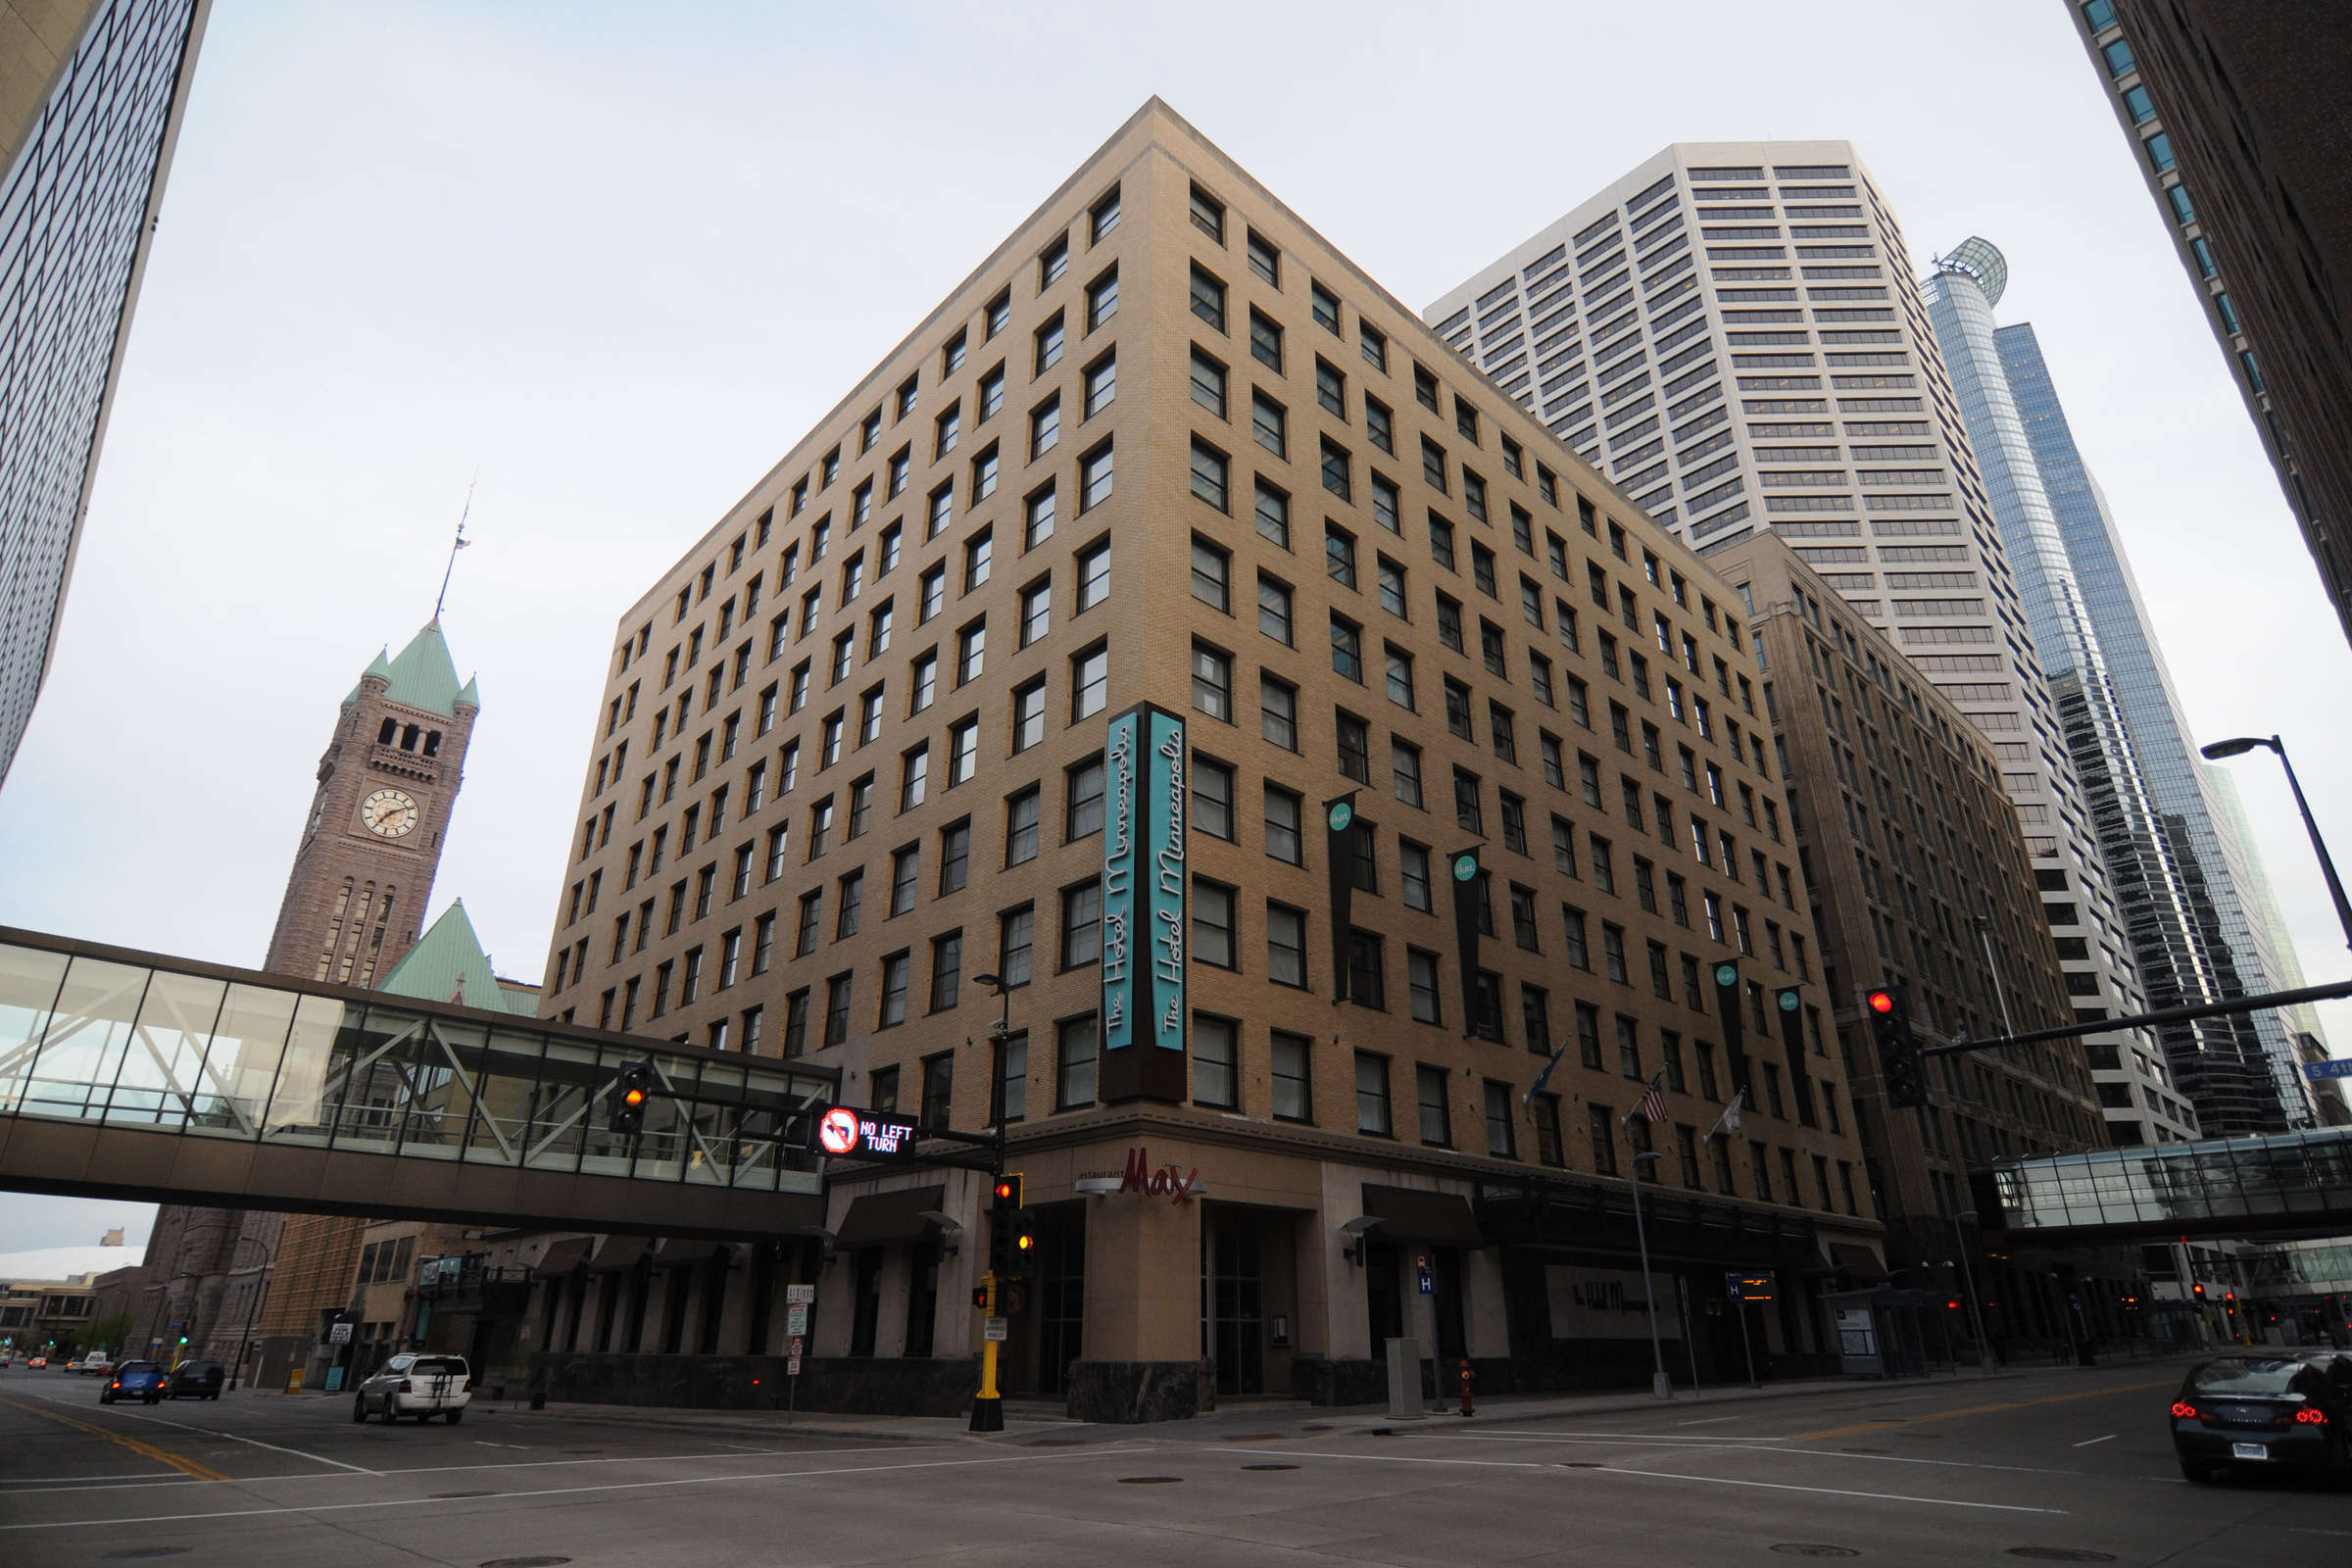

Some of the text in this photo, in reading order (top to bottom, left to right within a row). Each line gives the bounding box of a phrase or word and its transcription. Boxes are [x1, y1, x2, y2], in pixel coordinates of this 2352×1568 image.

[1103, 724, 1130, 1036] The Hotel Minneapolis
[1157, 728, 1185, 1035] The Hotel Minneapolis
[2312, 1065, 2322, 1078] S
[859, 1120, 912, 1142] NO LEFT
[866, 1136, 899, 1153] TURN
[1118, 1147, 1199, 1206] Max
[1421, 1277, 1432, 1292] H
